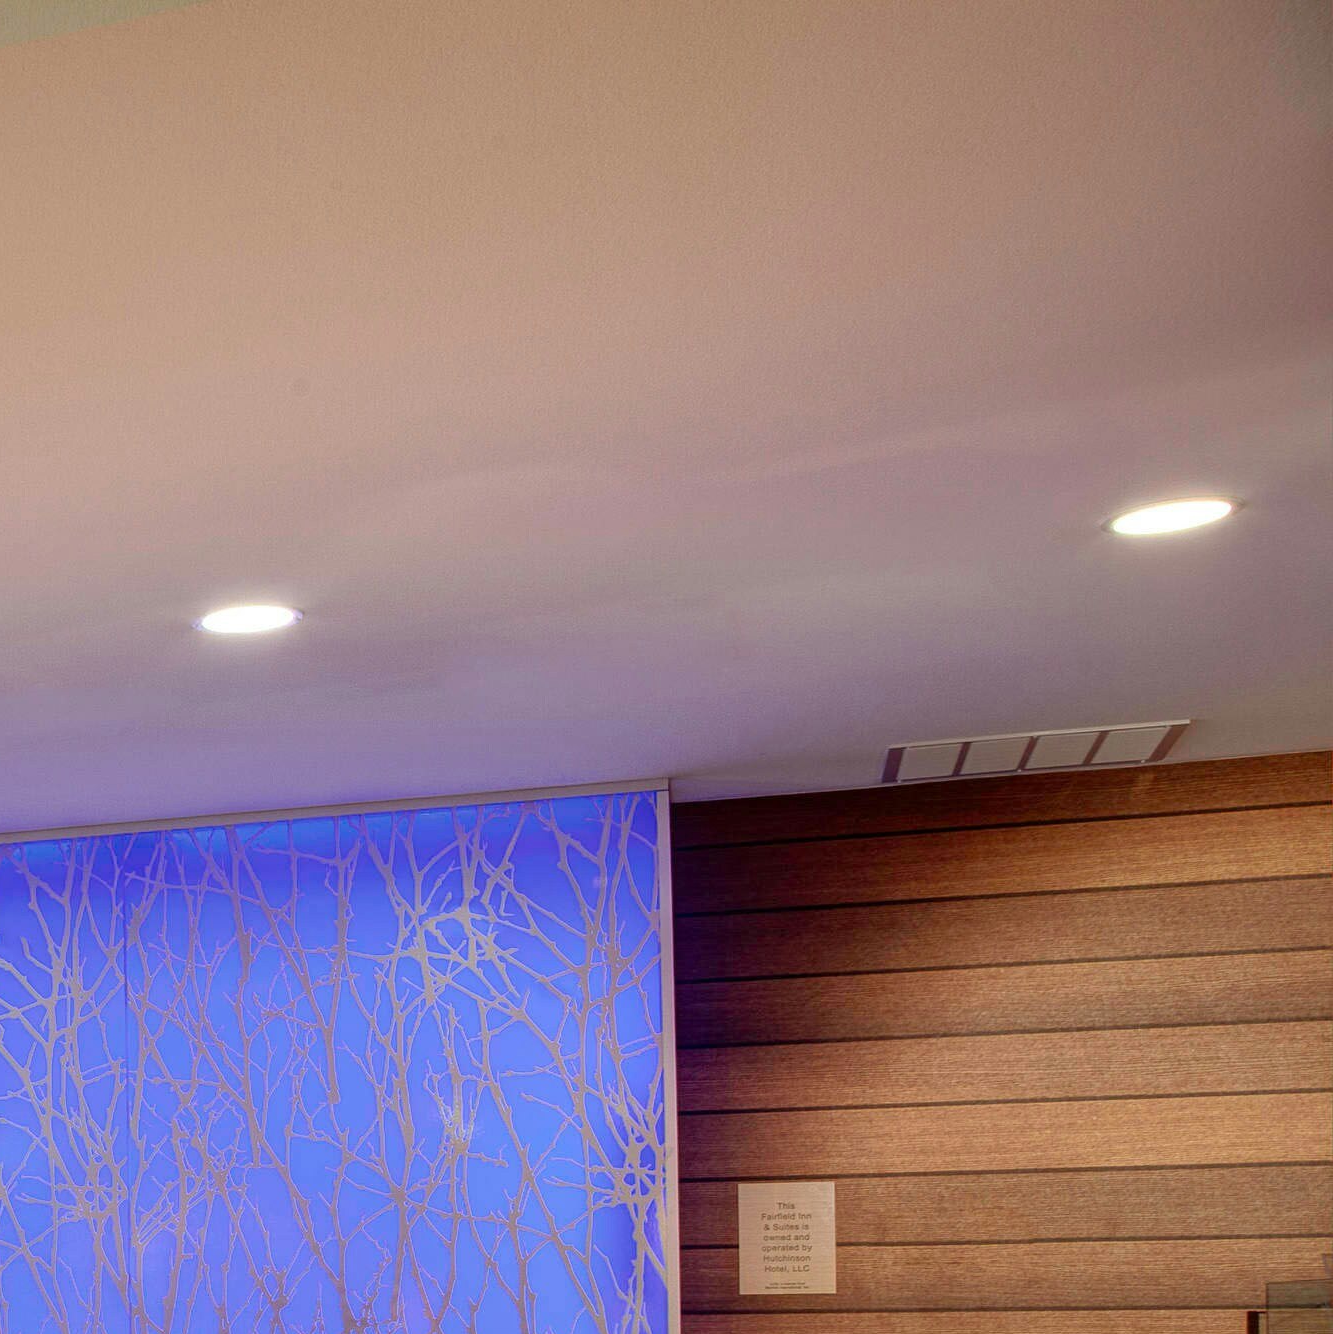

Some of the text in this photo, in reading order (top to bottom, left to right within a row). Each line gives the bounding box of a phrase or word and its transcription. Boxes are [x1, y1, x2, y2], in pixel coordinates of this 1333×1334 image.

[761, 1244, 812, 1253] operated by
[764, 1265, 789, 1273] Hotel,
